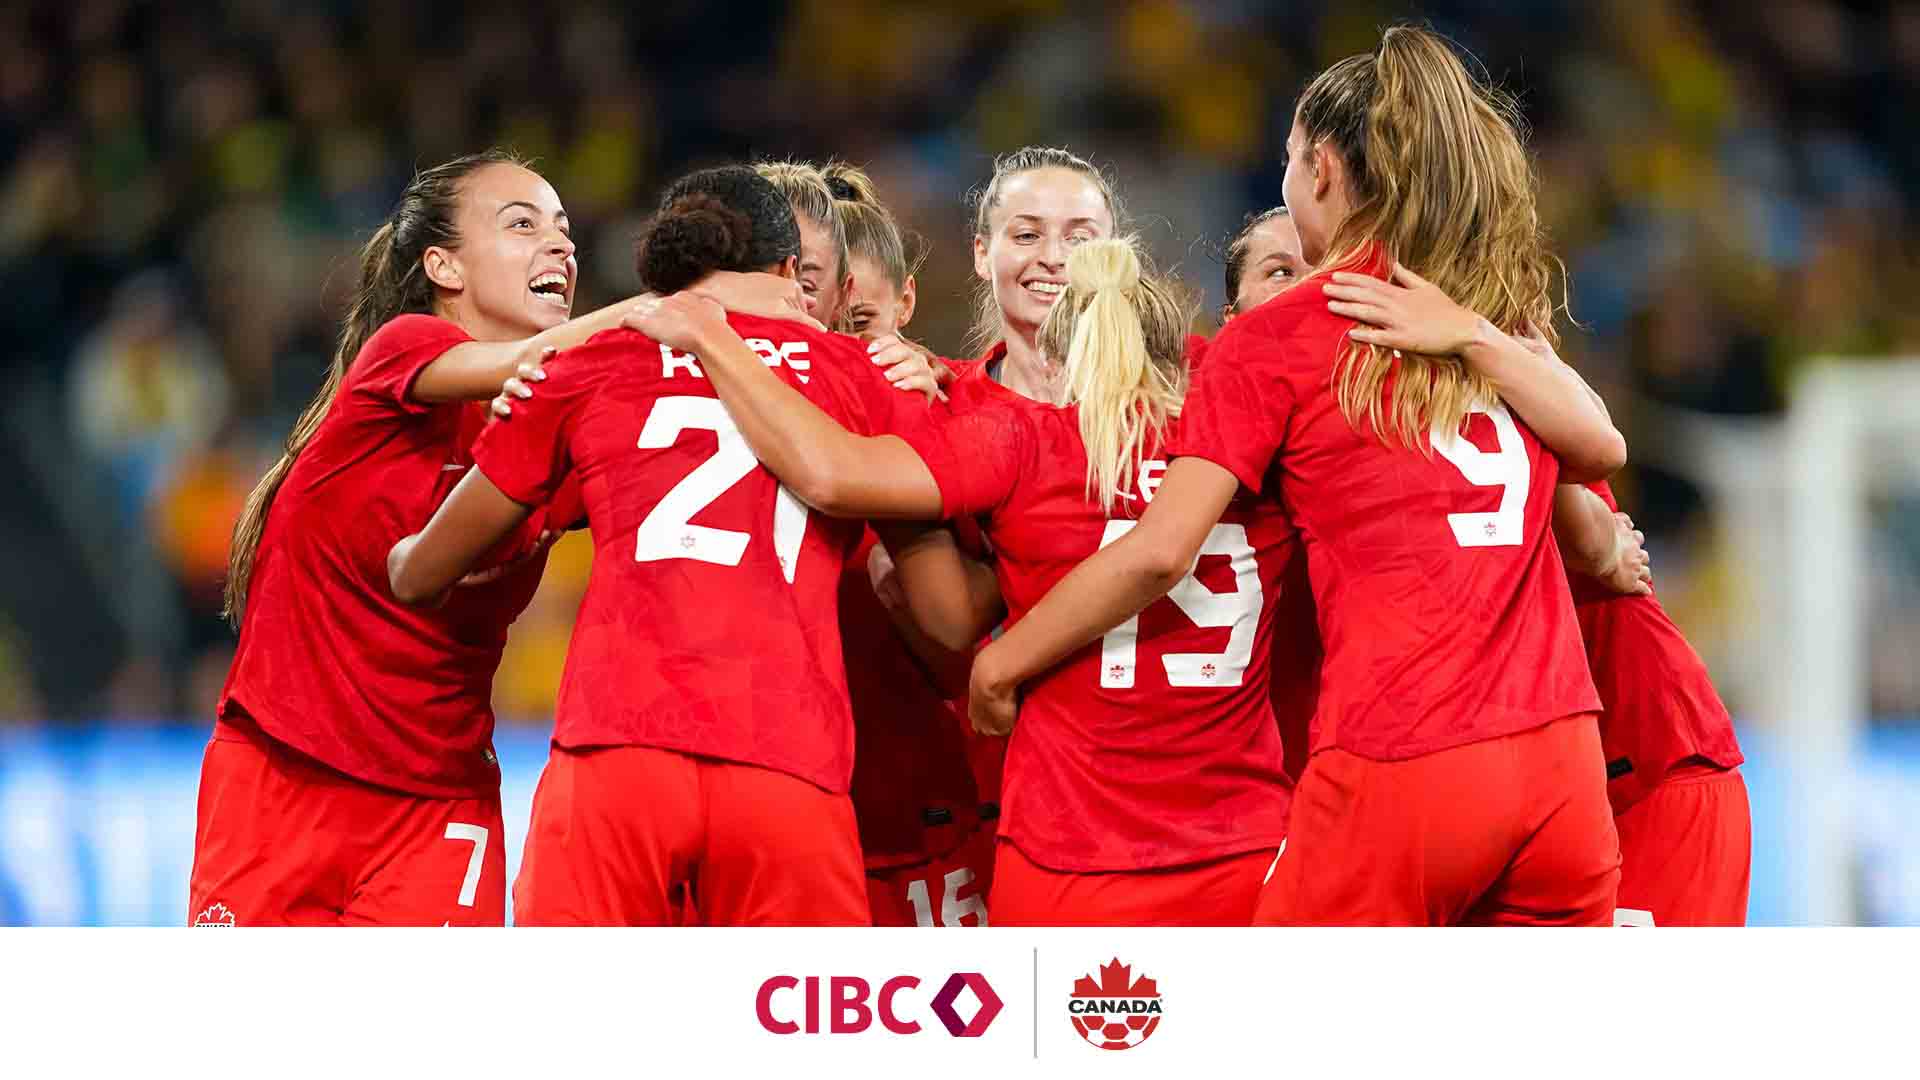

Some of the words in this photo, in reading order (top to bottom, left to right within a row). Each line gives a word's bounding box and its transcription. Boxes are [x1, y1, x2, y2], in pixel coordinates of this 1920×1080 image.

[1430, 404, 1530, 546] 9
[1098, 519, 1263, 688] 19
[444, 823, 489, 906] 7
[906, 867, 988, 927] 16
